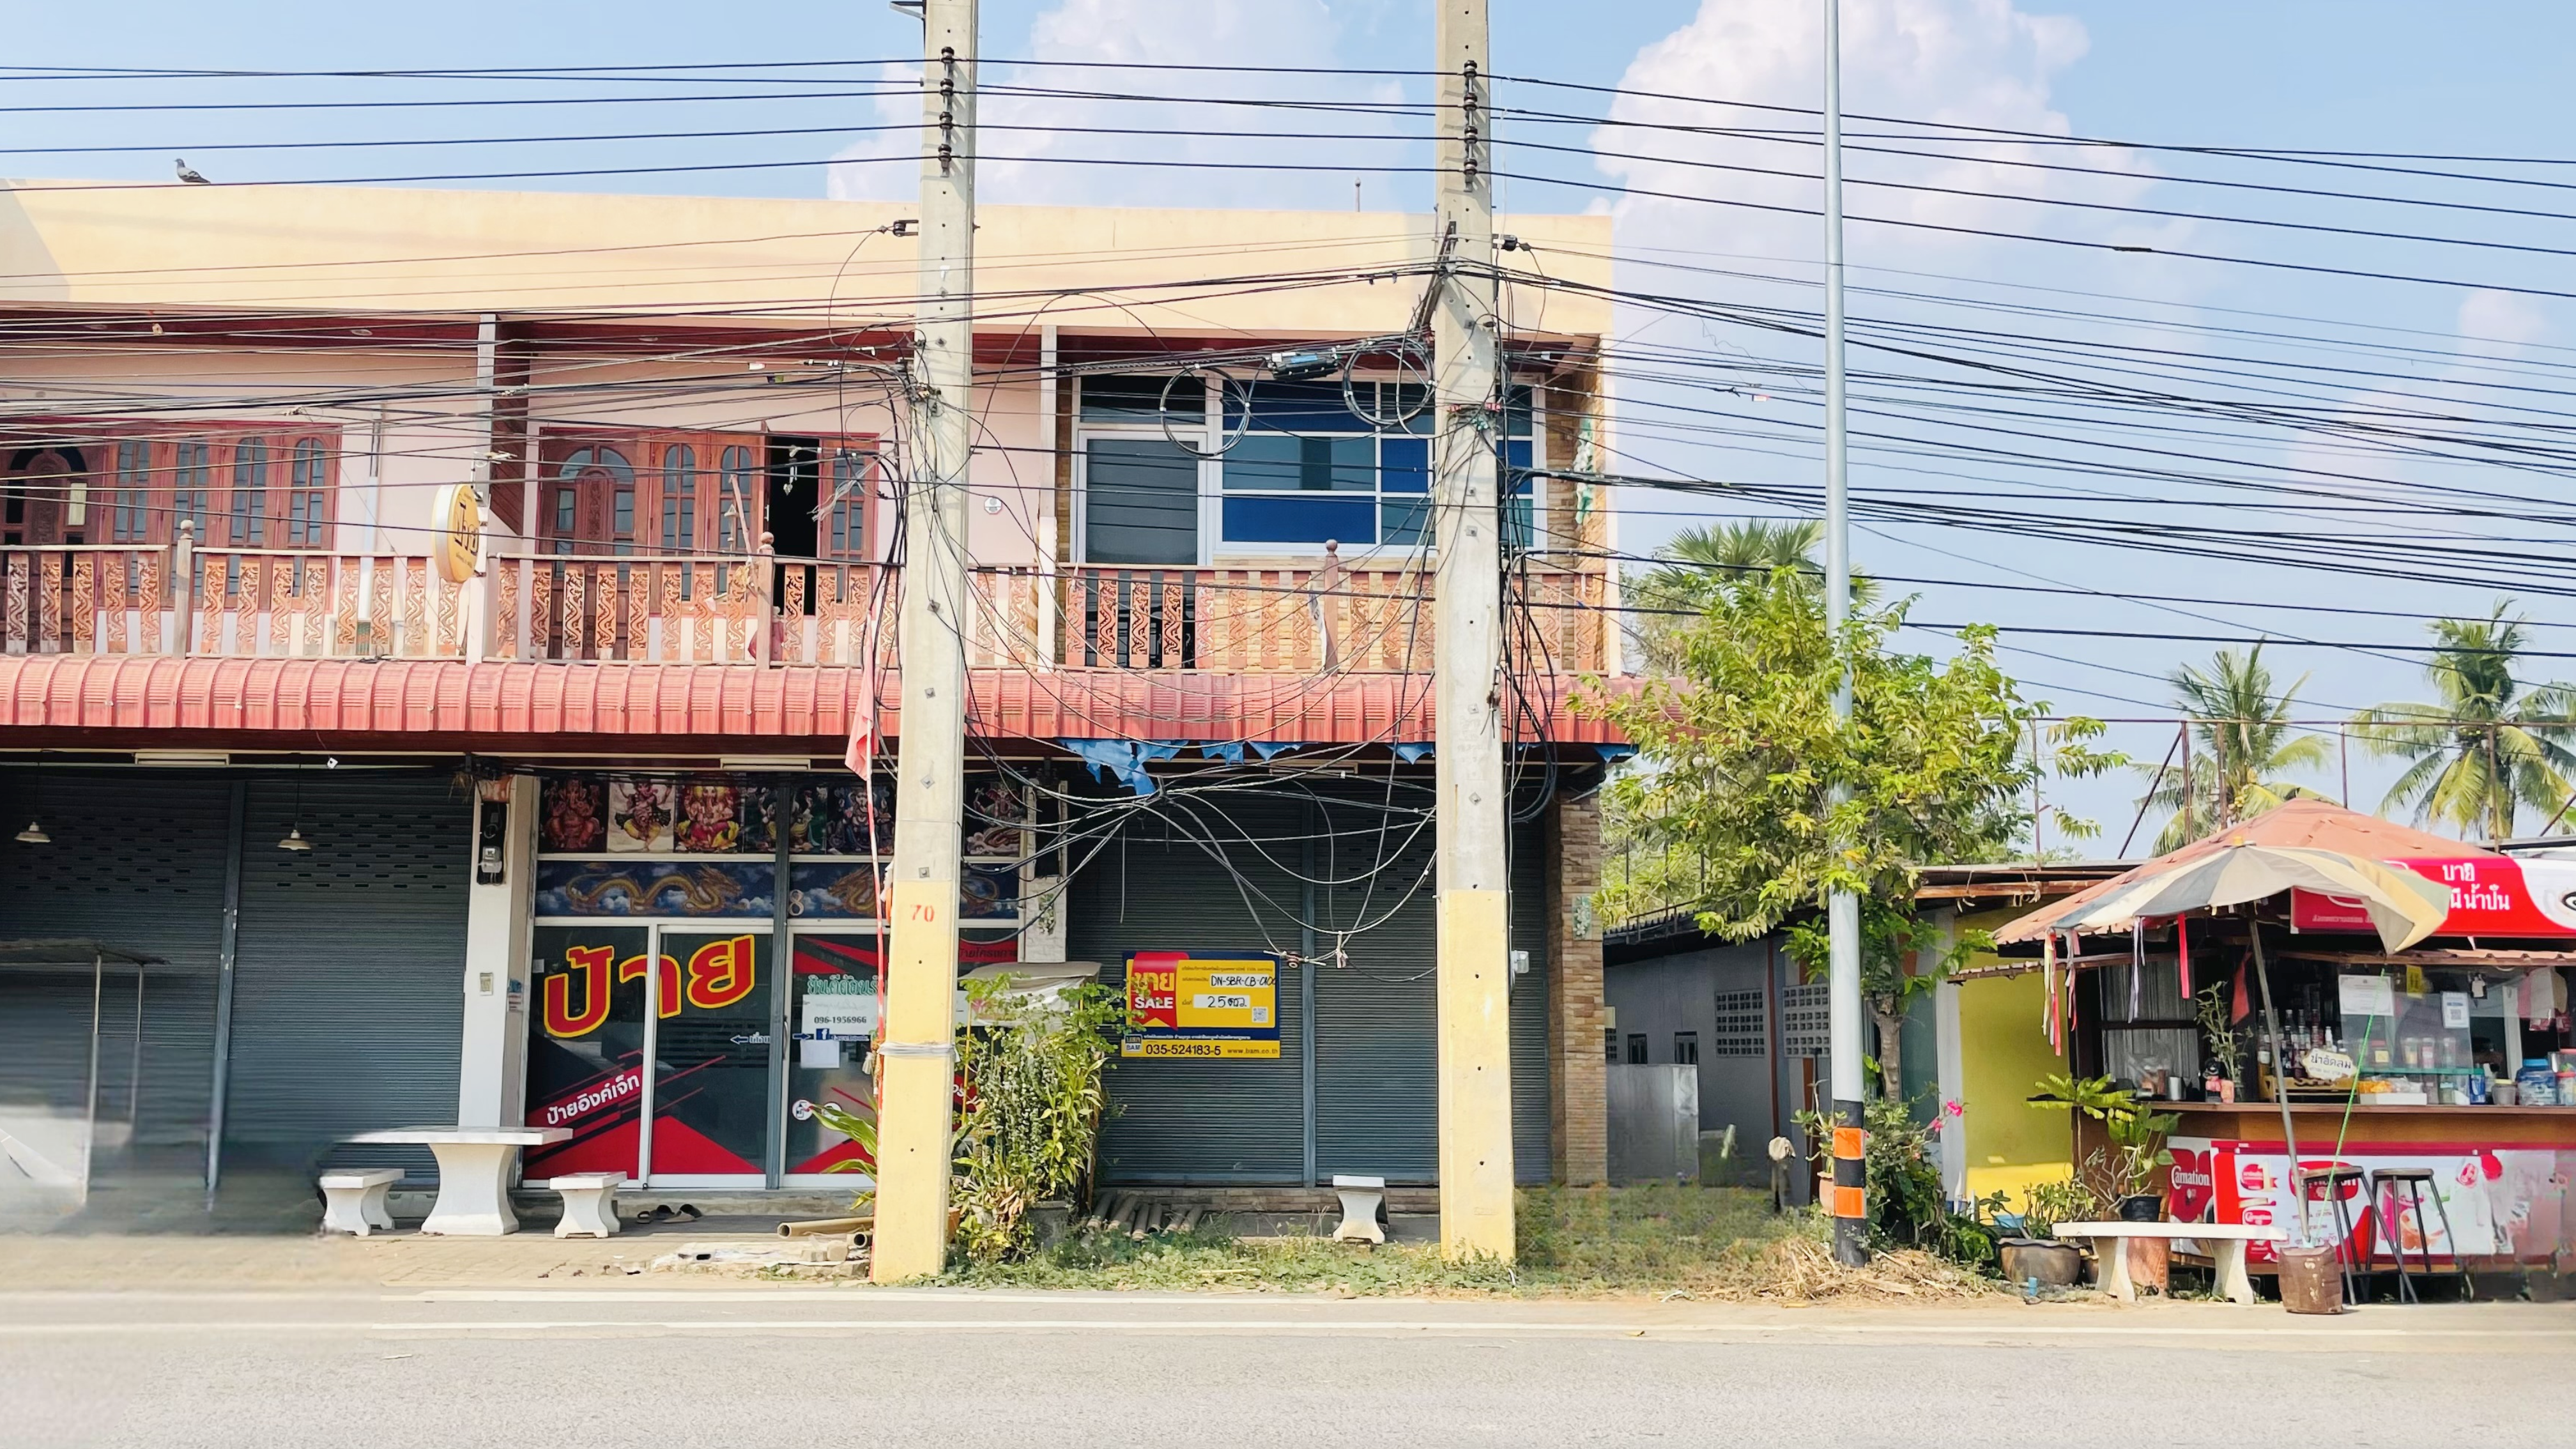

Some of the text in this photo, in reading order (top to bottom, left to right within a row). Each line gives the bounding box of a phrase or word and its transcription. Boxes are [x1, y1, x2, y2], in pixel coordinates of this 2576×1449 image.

[789, 889, 804, 916] 8
[910, 905, 935, 922] 70
[544, 934, 755, 1038] ป้าย
[807, 974, 880, 995] ยินดีต้อนรั
[1133, 972, 1174, 991] ขาย
[1134, 997, 1174, 1009] SALE
[1146, 1044, 1221, 1055] 035-524183-5
[547, 1073, 640, 1125] ป้ายอิงค์เจ็ท
[2171, 1165, 2211, 1190] Carnation
